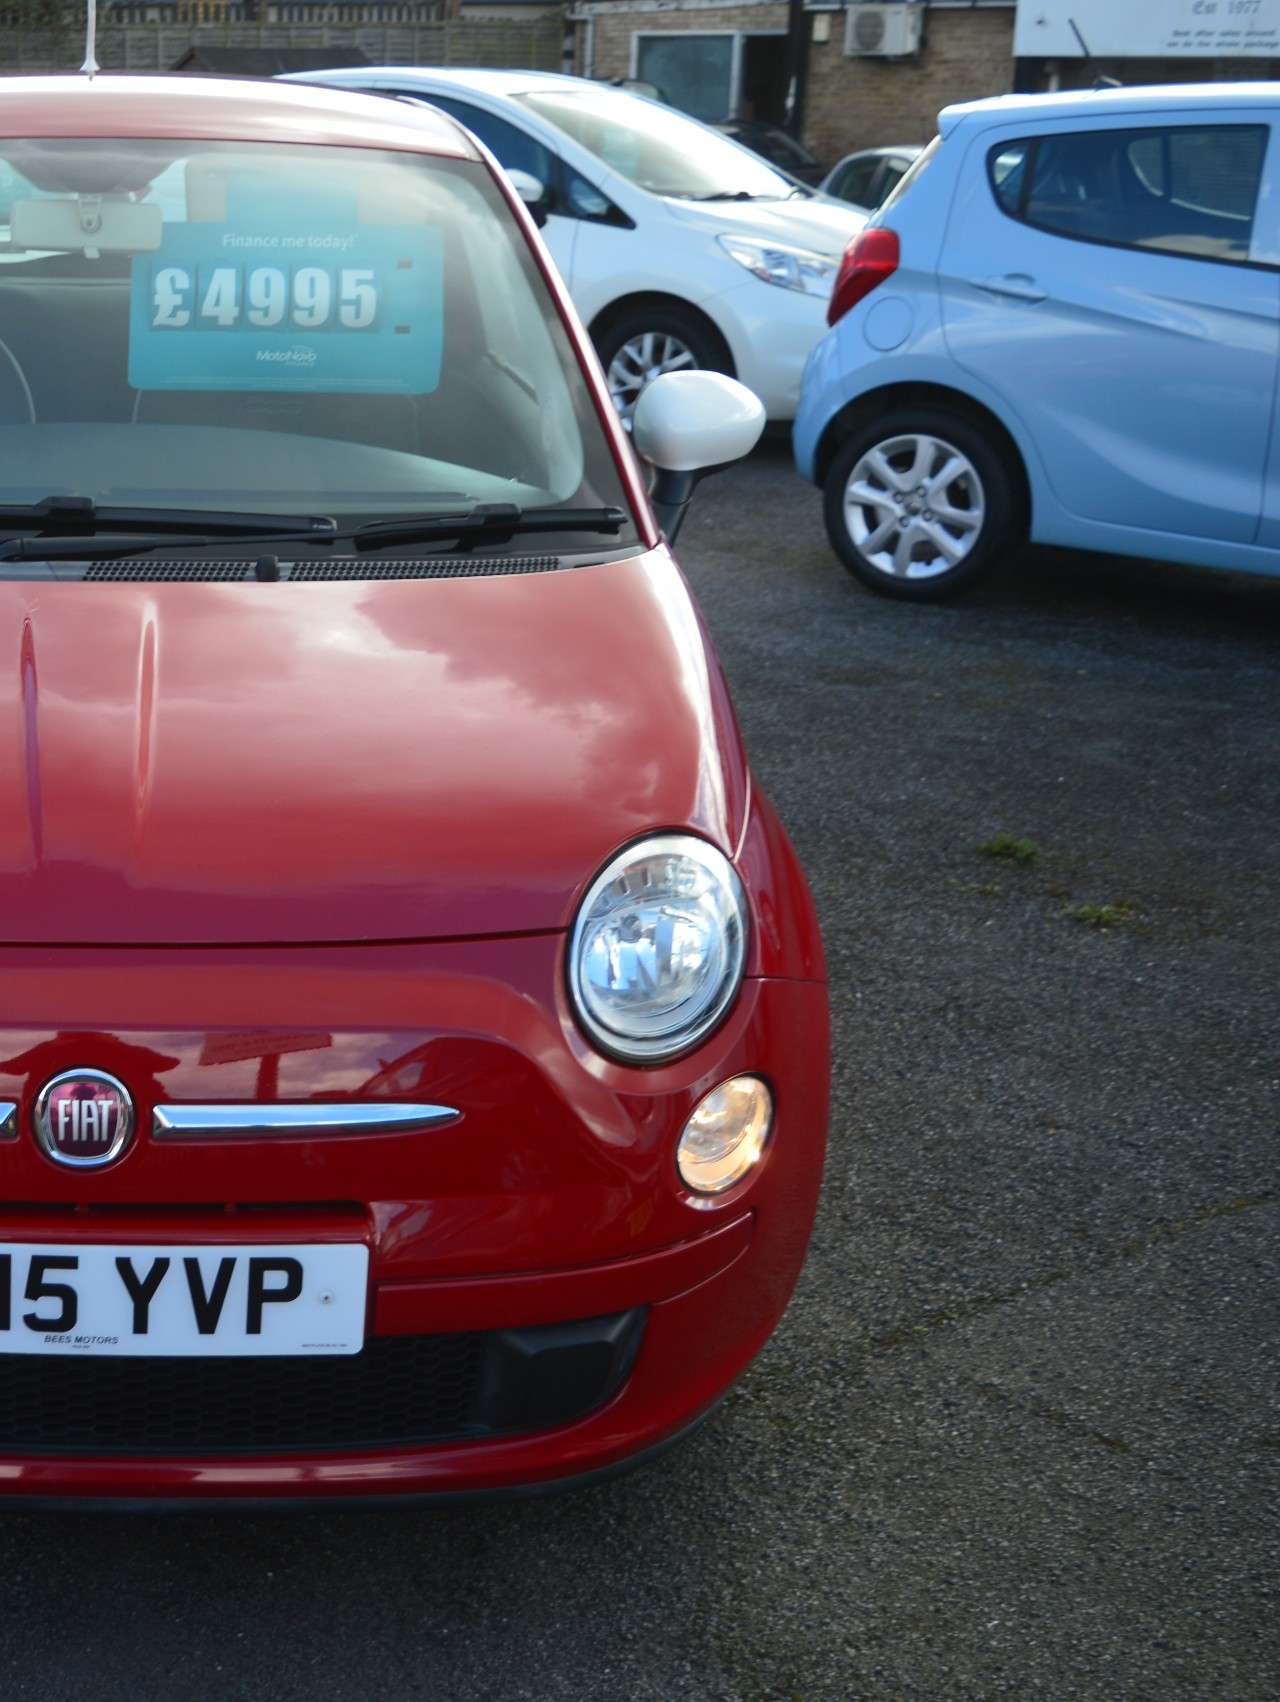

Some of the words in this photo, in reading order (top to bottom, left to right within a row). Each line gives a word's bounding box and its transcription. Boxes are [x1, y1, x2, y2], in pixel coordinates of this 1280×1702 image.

[223, 233, 279, 248] Finance
[281, 237, 304, 248] me
[152, 266, 378, 329] £4995
[58, 1099, 114, 1142] FIAT
[114, 1256, 304, 1336] YVP
[74, 1335, 120, 1345] MOTORS
